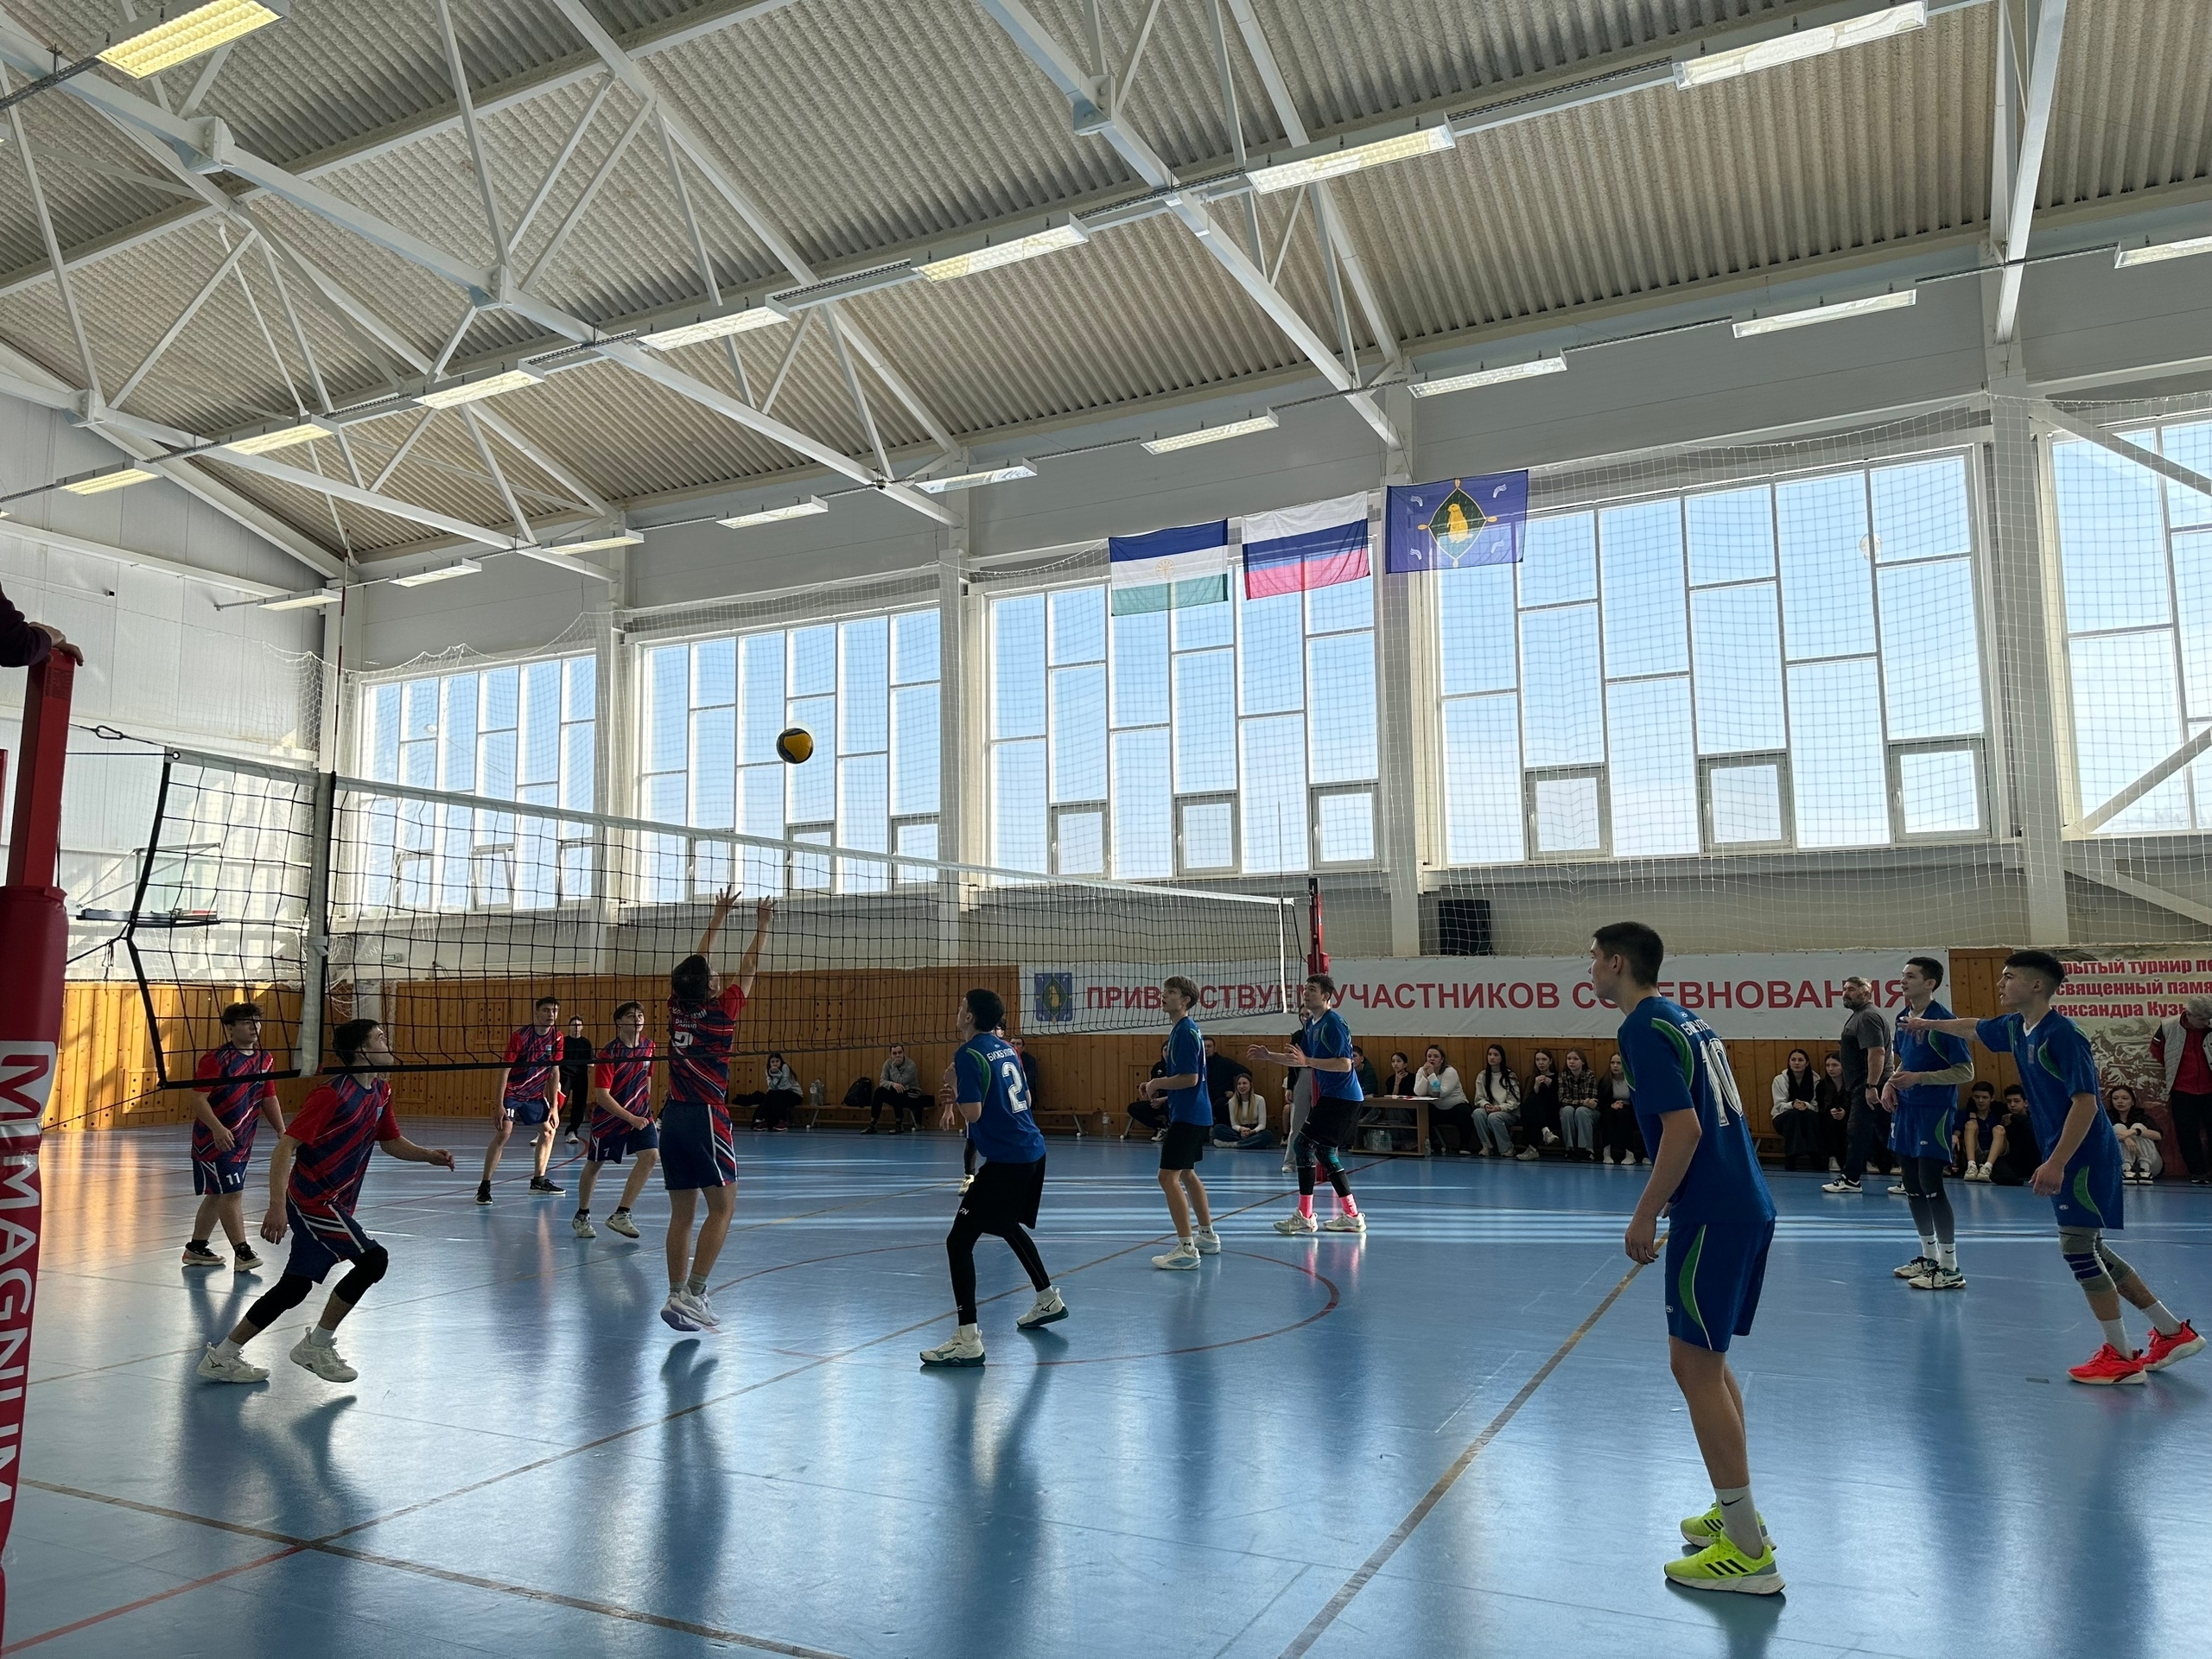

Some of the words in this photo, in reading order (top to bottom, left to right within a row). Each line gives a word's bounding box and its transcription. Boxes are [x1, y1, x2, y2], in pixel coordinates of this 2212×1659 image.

[2063, 958, 2126, 976] рытый
[2128, 959, 2192, 975] турнир
[1087, 984, 1305, 1009] ПРИВСТВУЕ
[1332, 982, 1560, 1009] УЧАСТНИКОВ
[1571, 979, 1910, 1009] СЕВНОВАНЯ
[2056, 978, 2163, 997] священный
[2051, 1002, 2144, 1018] ександра
[1001, 1061, 1028, 1114] 2
[1700, 1038, 1743, 1127] 10
[226, 1172, 241, 1185] 11
